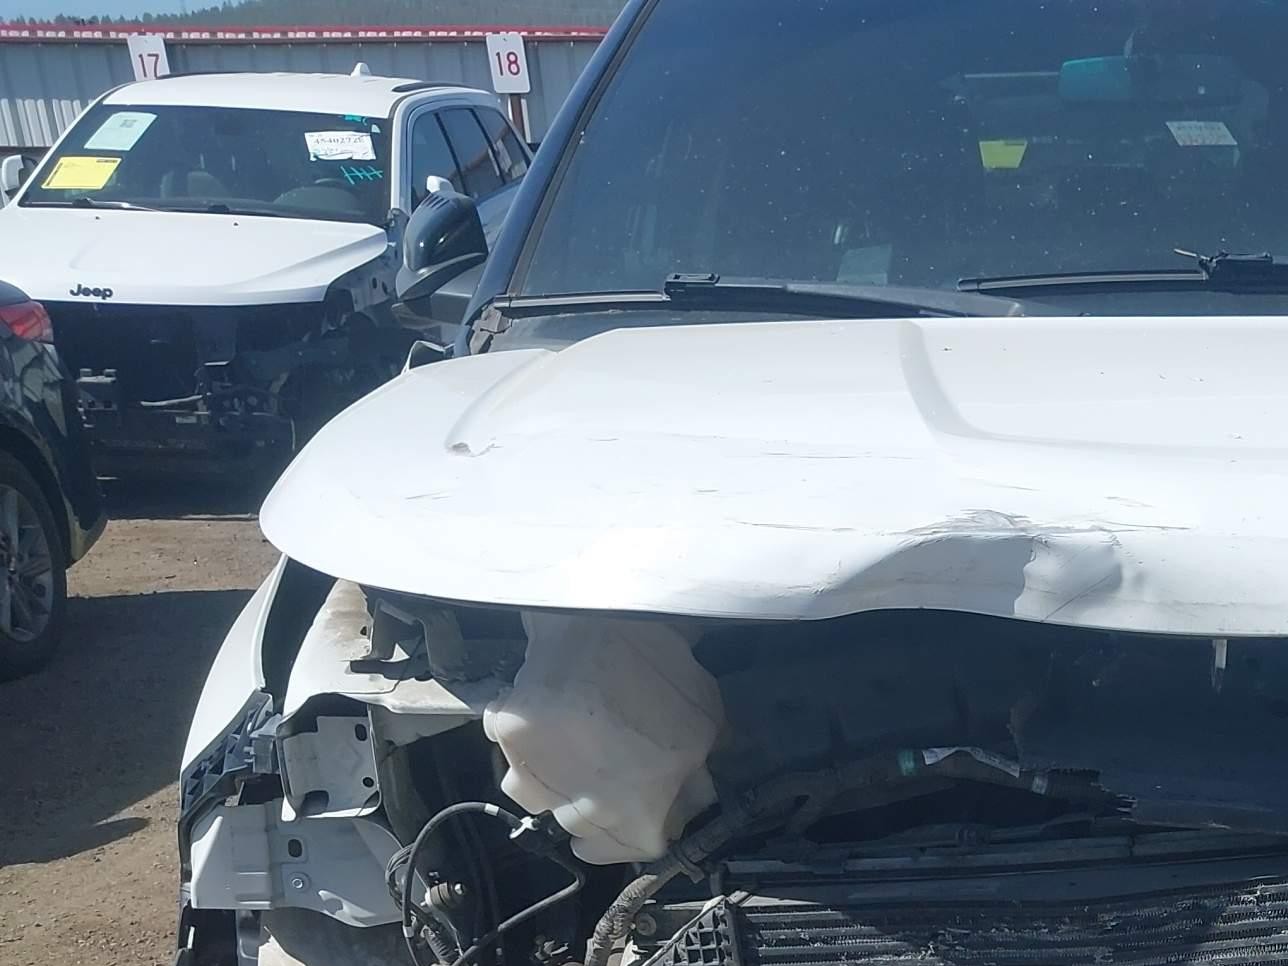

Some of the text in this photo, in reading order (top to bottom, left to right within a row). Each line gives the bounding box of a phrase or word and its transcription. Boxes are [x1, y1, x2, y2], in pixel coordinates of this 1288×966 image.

[138, 53, 160, 79] 17
[495, 51, 520, 76] 18
[69, 283, 114, 300] Jeep
